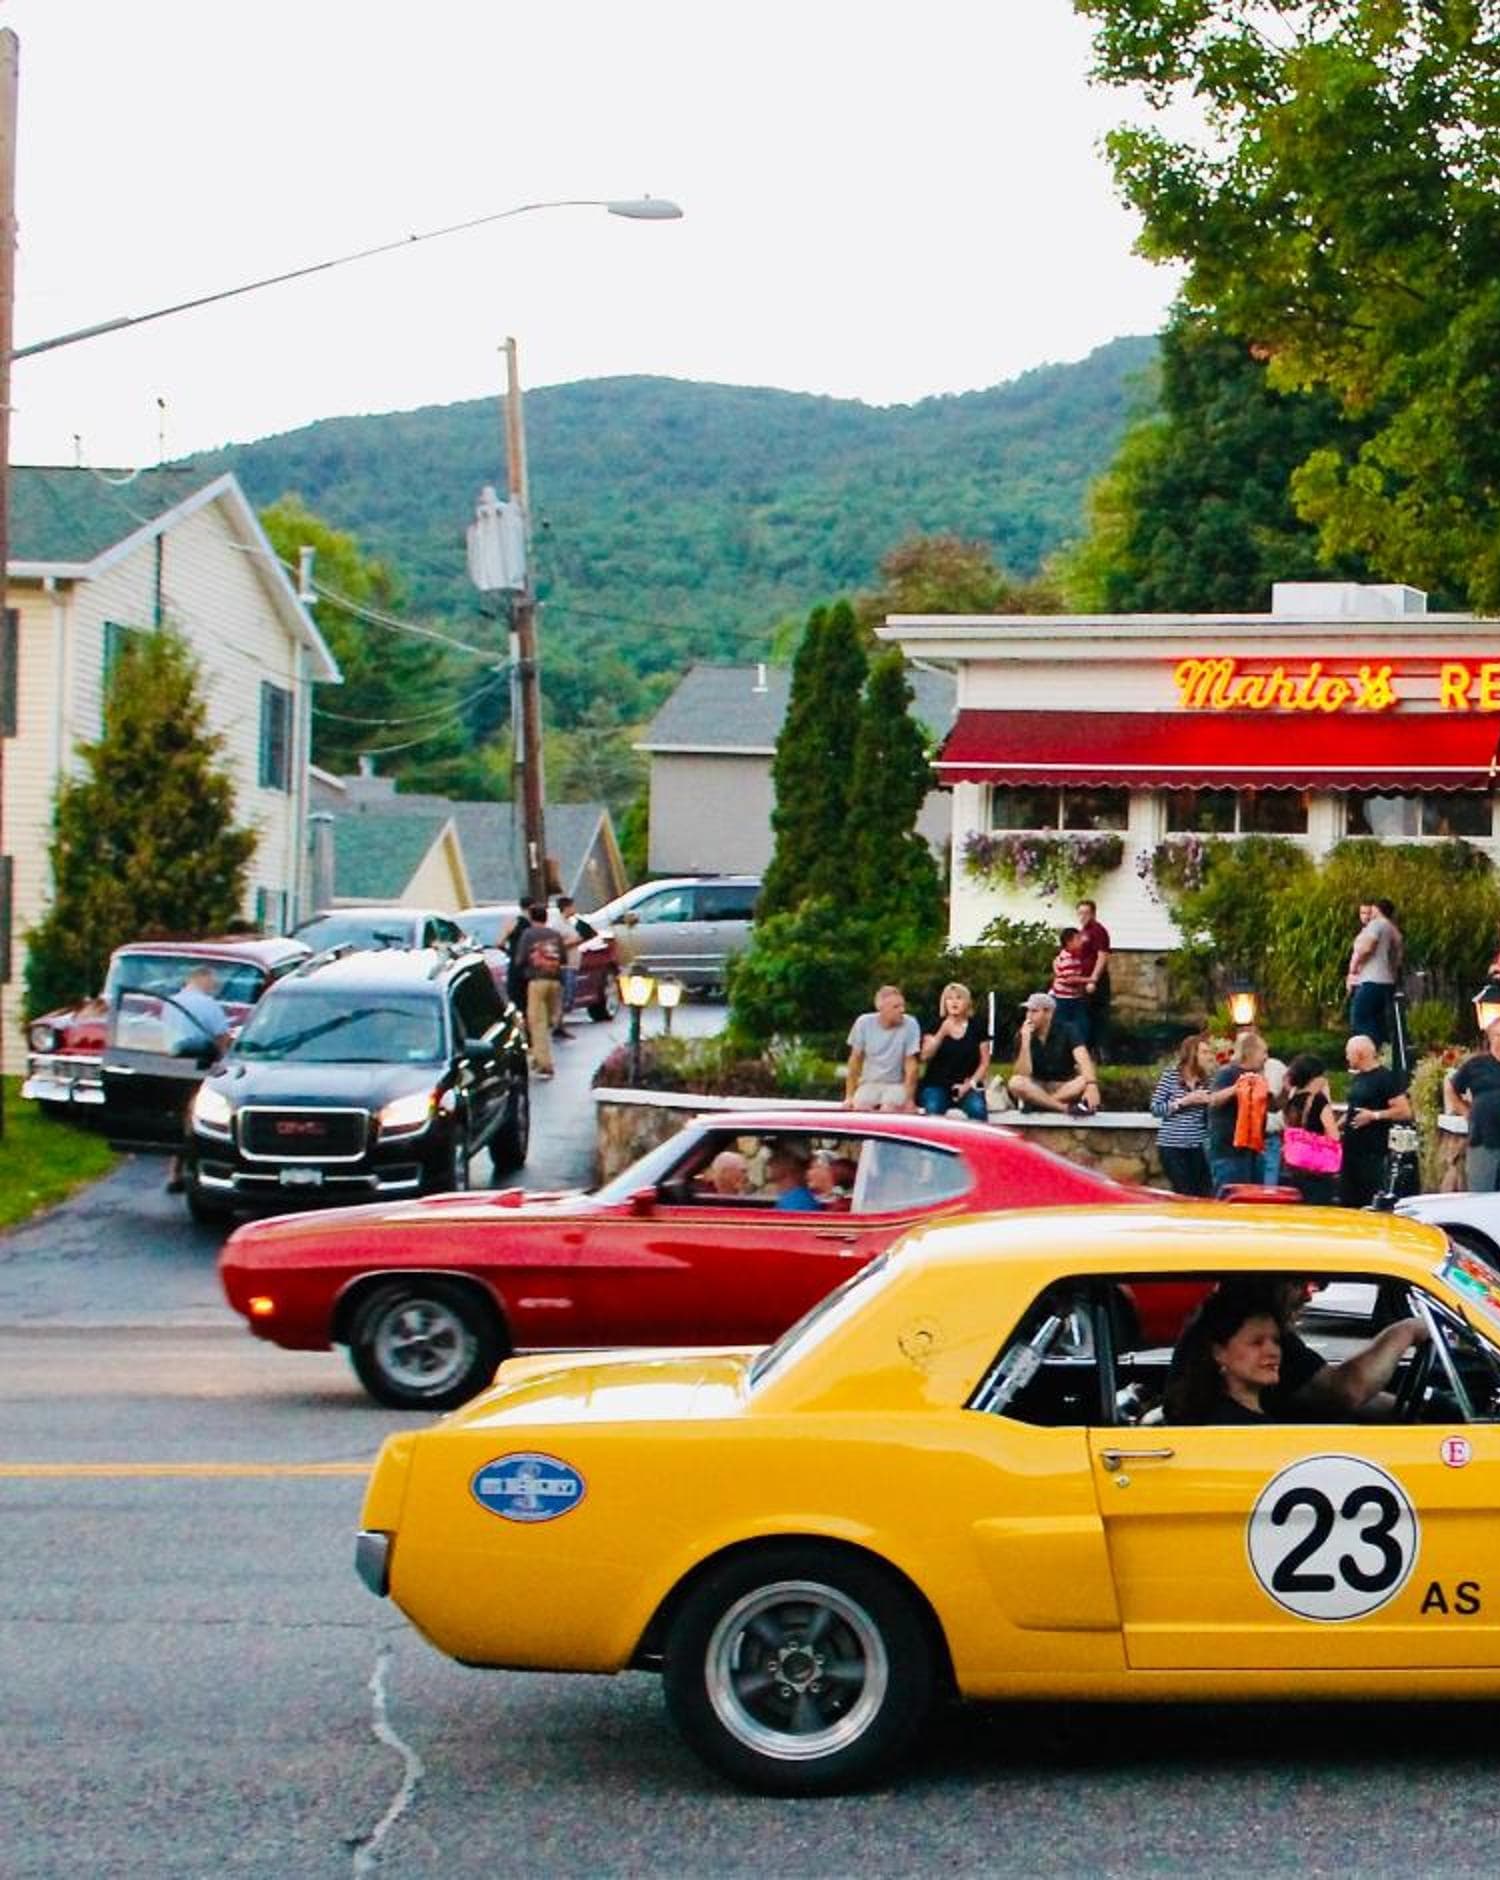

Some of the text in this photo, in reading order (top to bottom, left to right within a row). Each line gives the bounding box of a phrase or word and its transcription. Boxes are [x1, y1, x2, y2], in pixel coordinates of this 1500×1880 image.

[1448, 1441, 1466, 1464] E
[1270, 1485, 1404, 1593] 23
[1419, 1580, 1481, 1615] AS
